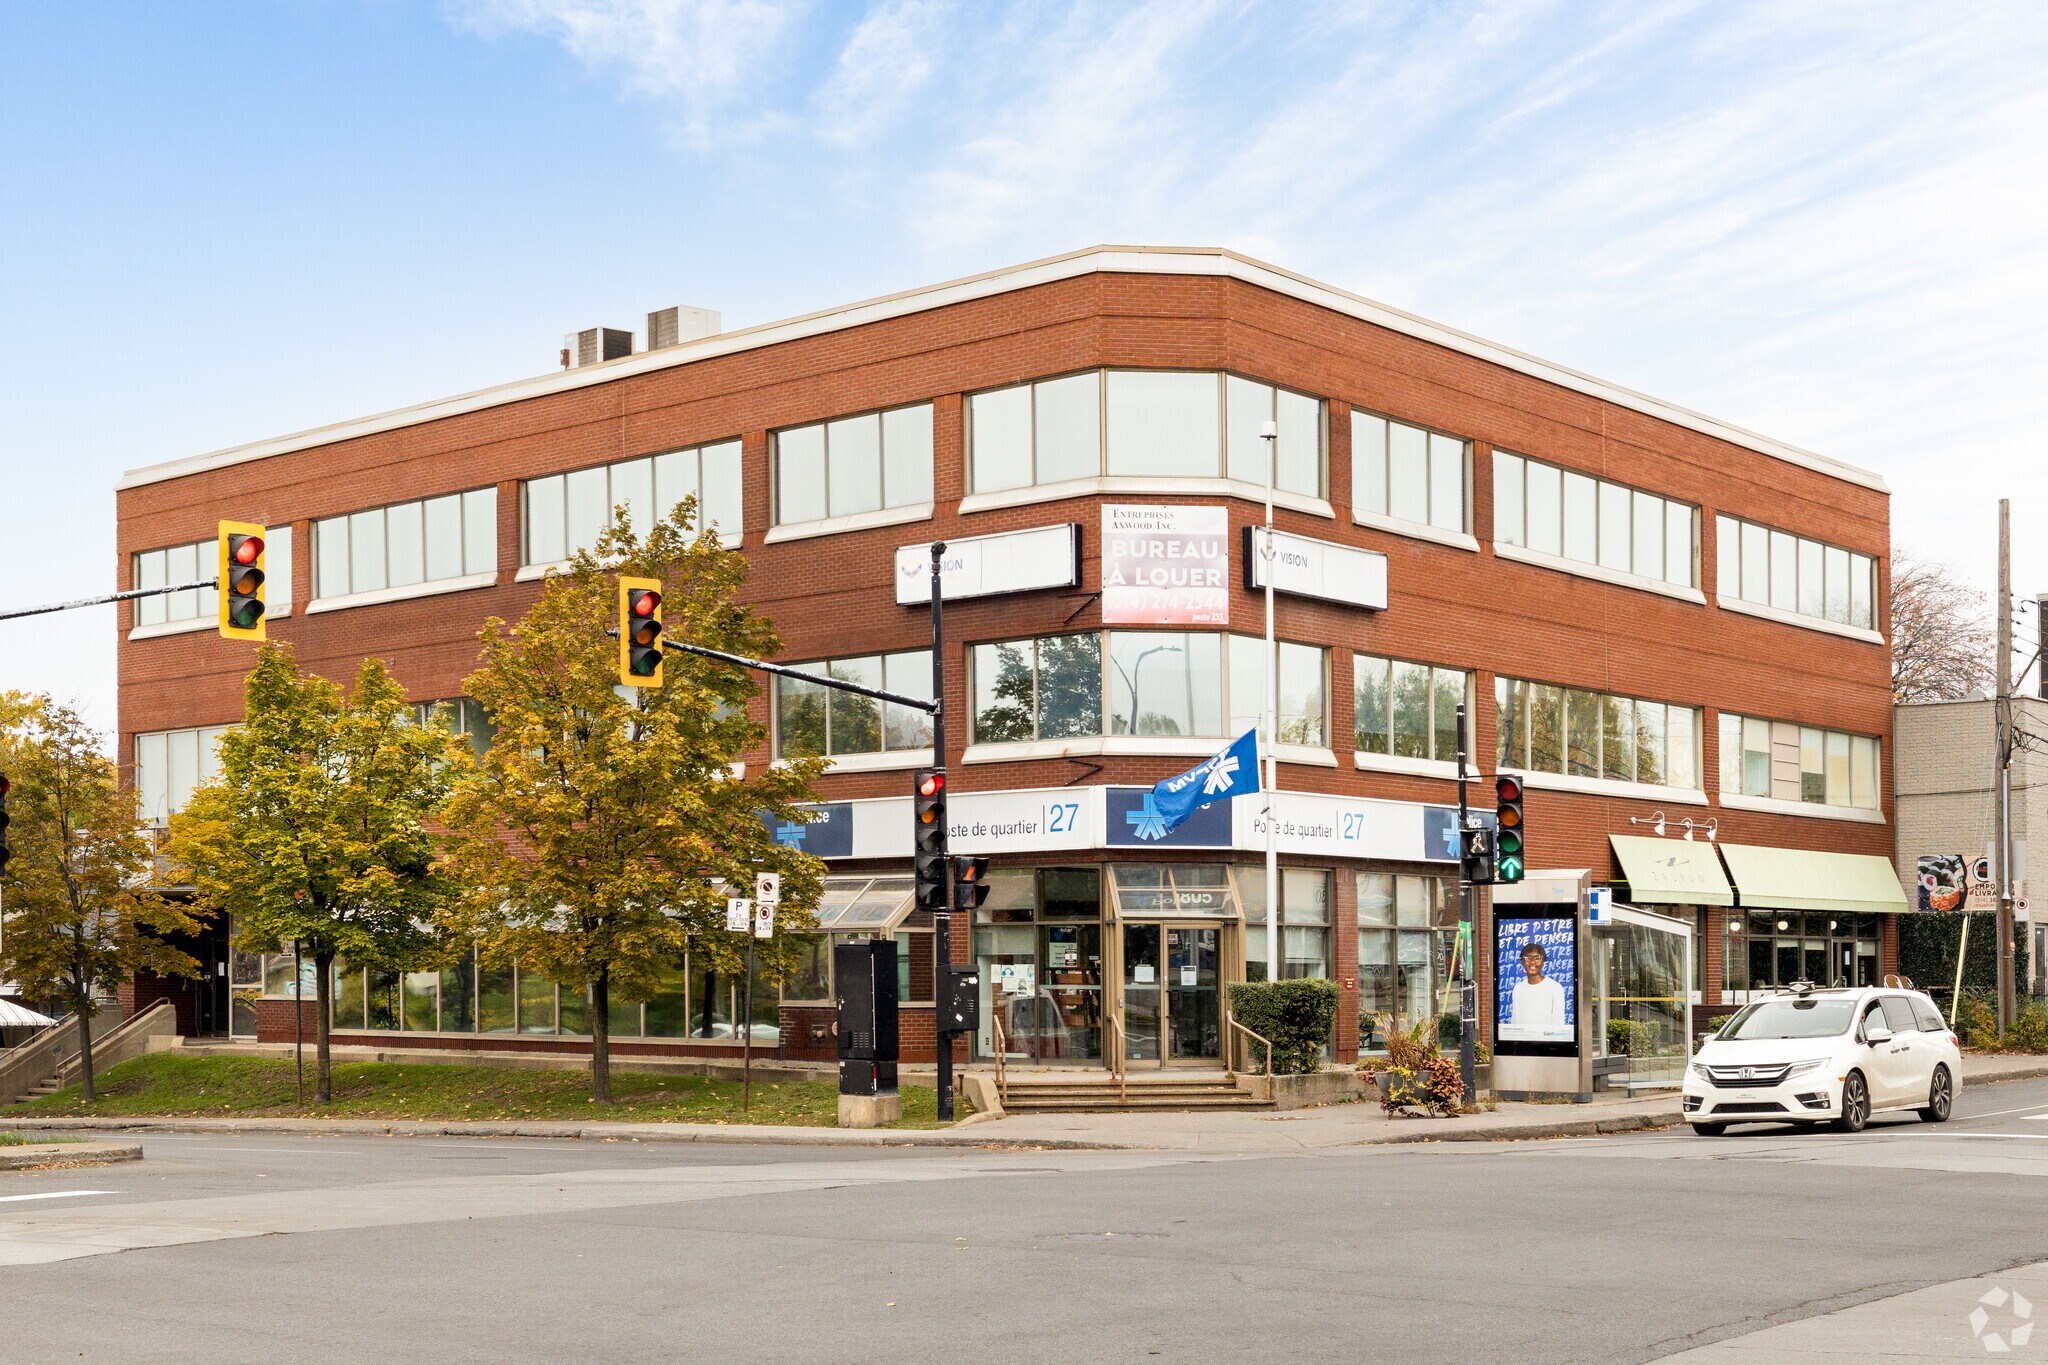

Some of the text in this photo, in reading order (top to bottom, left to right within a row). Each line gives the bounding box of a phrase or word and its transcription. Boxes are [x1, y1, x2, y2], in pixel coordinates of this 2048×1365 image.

[1111, 540, 1218, 559] BUREAU
[1280, 551, 1308, 568] VISION
[1107, 562, 1222, 586] À LOUER
[972, 821, 987, 836] de
[991, 819, 1038, 838] quartier
[1050, 803, 1079, 832] 27
[1283, 821, 1295, 835] de
[1298, 823, 1333, 839] quartier
[1344, 812, 1364, 839] 27
[736, 902, 742, 910] P
[1498, 922, 1529, 936] LIBRE
[1499, 932, 1574, 949] ET DE PENSER
[1498, 950, 1521, 963] LIBR
[1499, 963, 1513, 976] ET
[1542, 959, 1574, 973] ENSER
